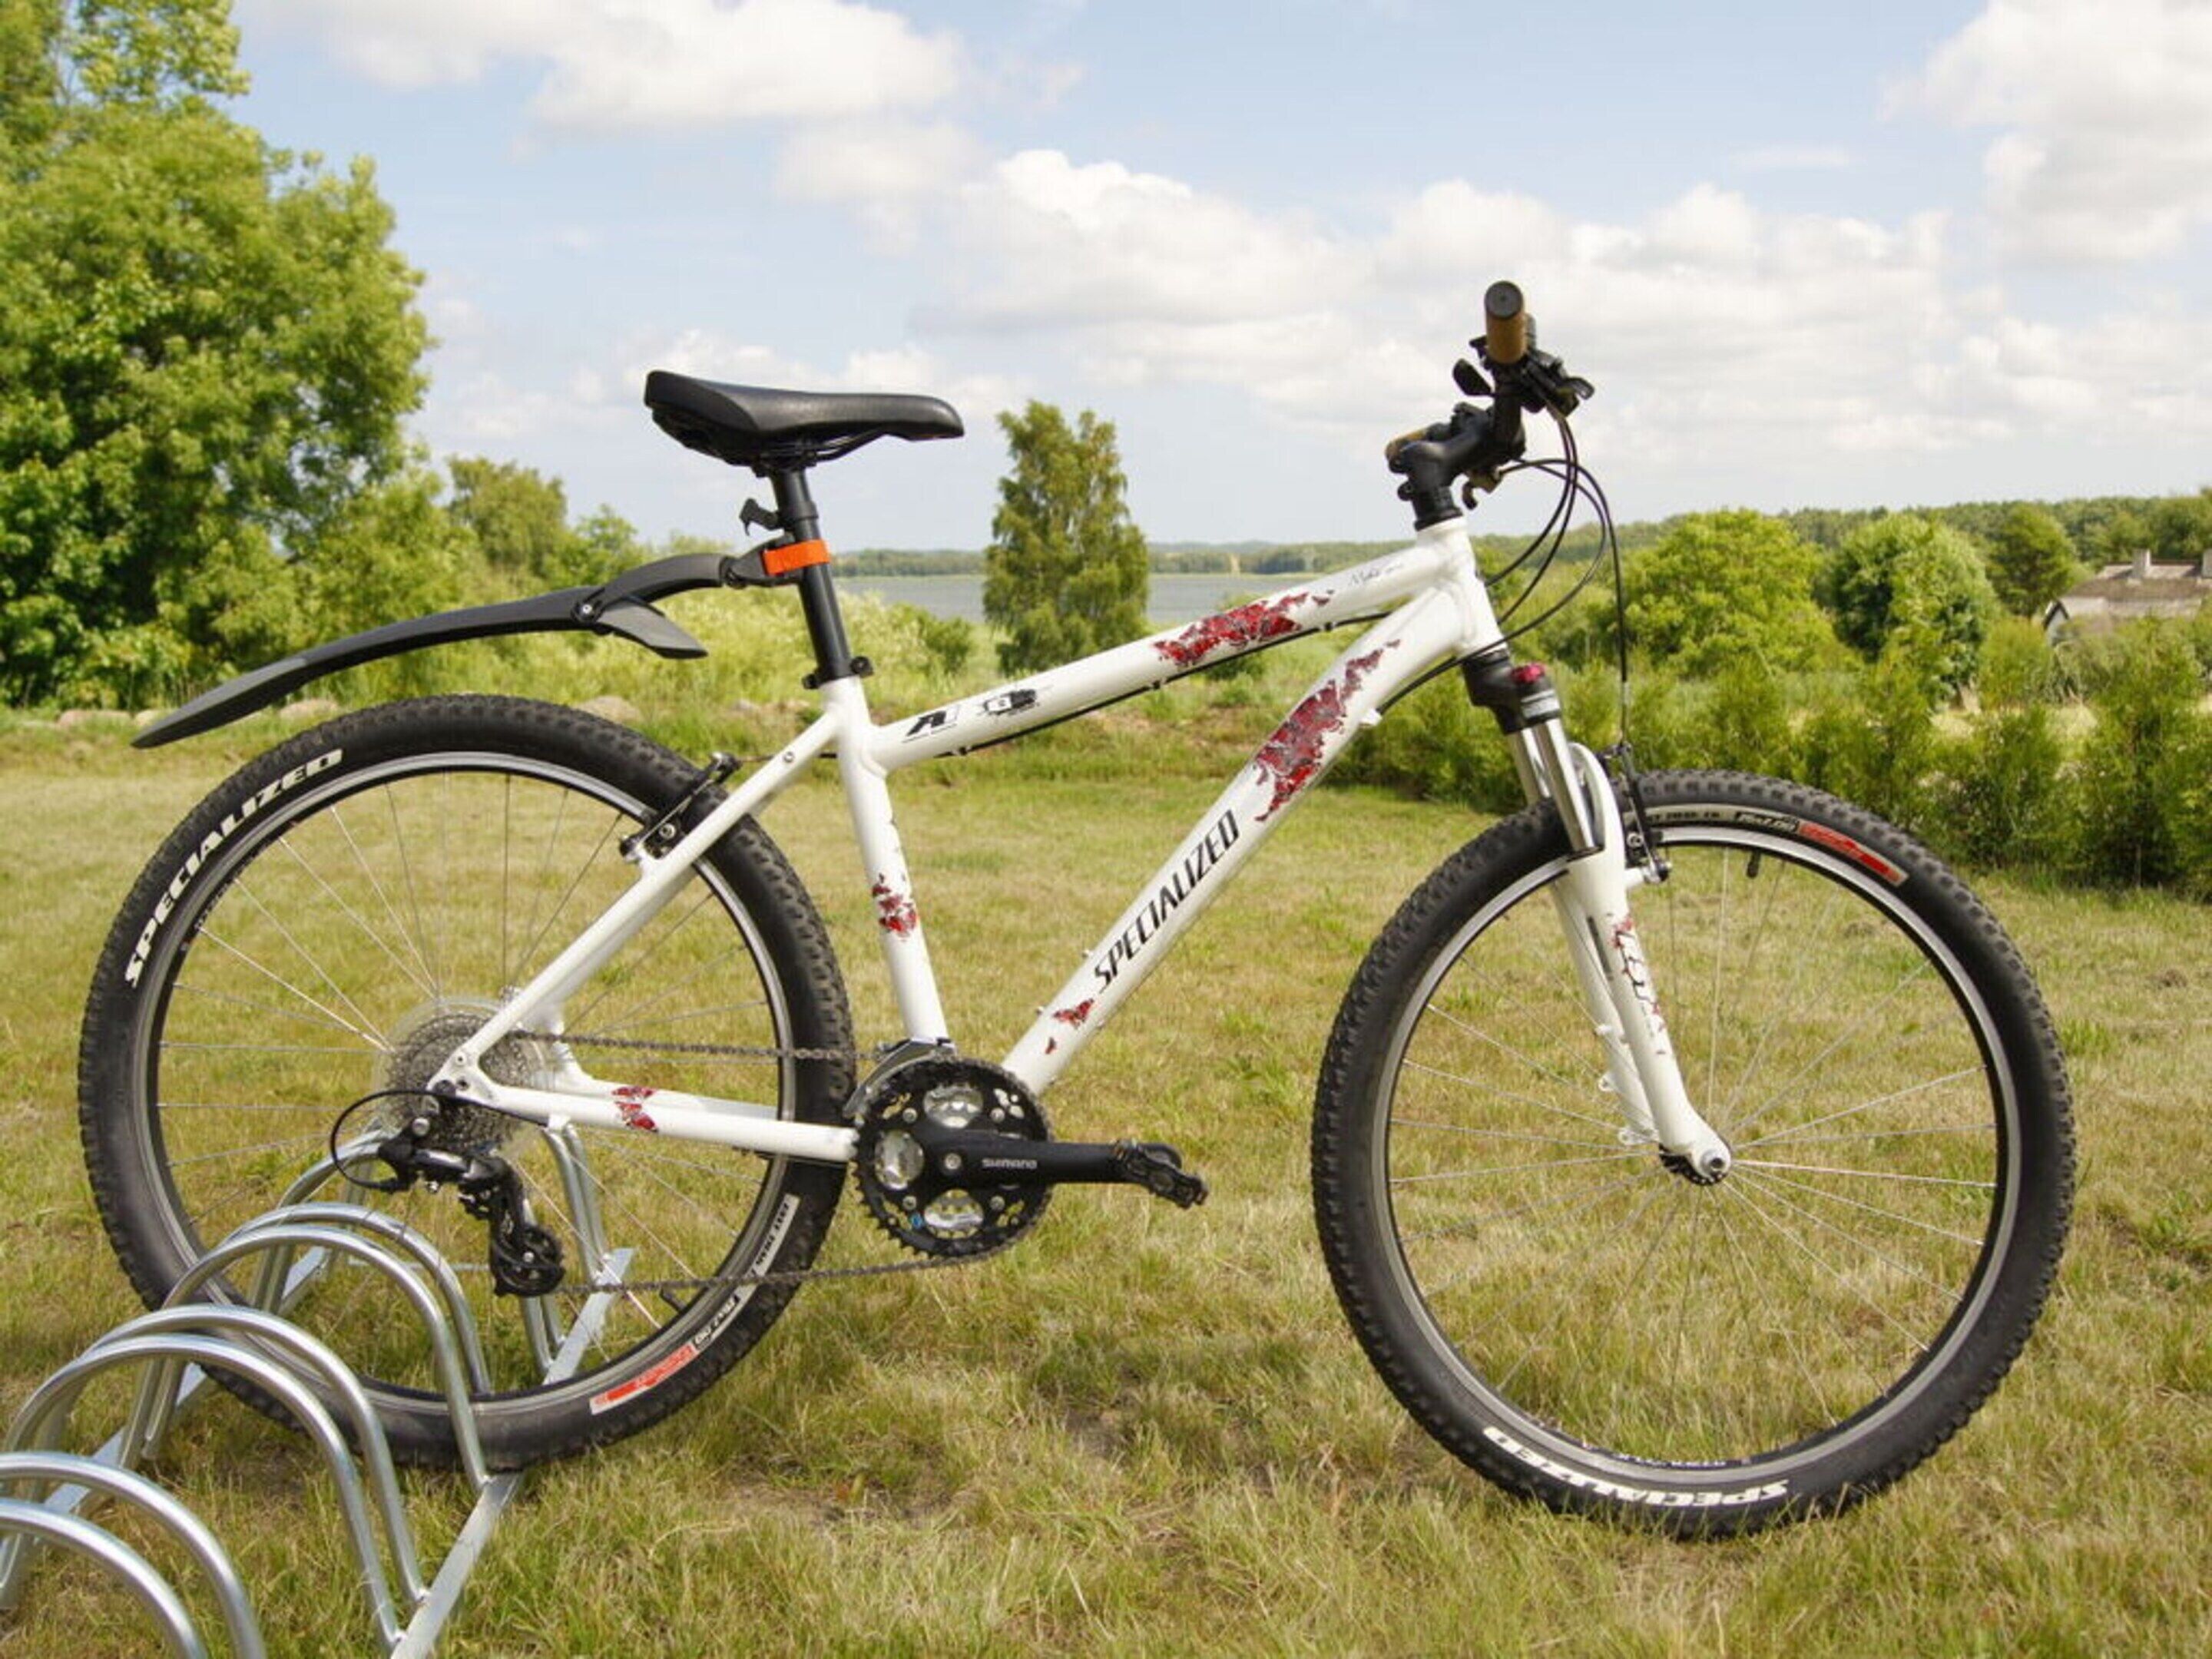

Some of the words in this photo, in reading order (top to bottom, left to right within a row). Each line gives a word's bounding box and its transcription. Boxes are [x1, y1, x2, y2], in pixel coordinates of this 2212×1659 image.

[125, 748, 343, 988] SPECIALIZED
[1094, 809, 1240, 995] SPECIALIZED
[982, 1157, 1038, 1170] SHIMANO
[1483, 1426, 1789, 1507] SPECIALIZED
